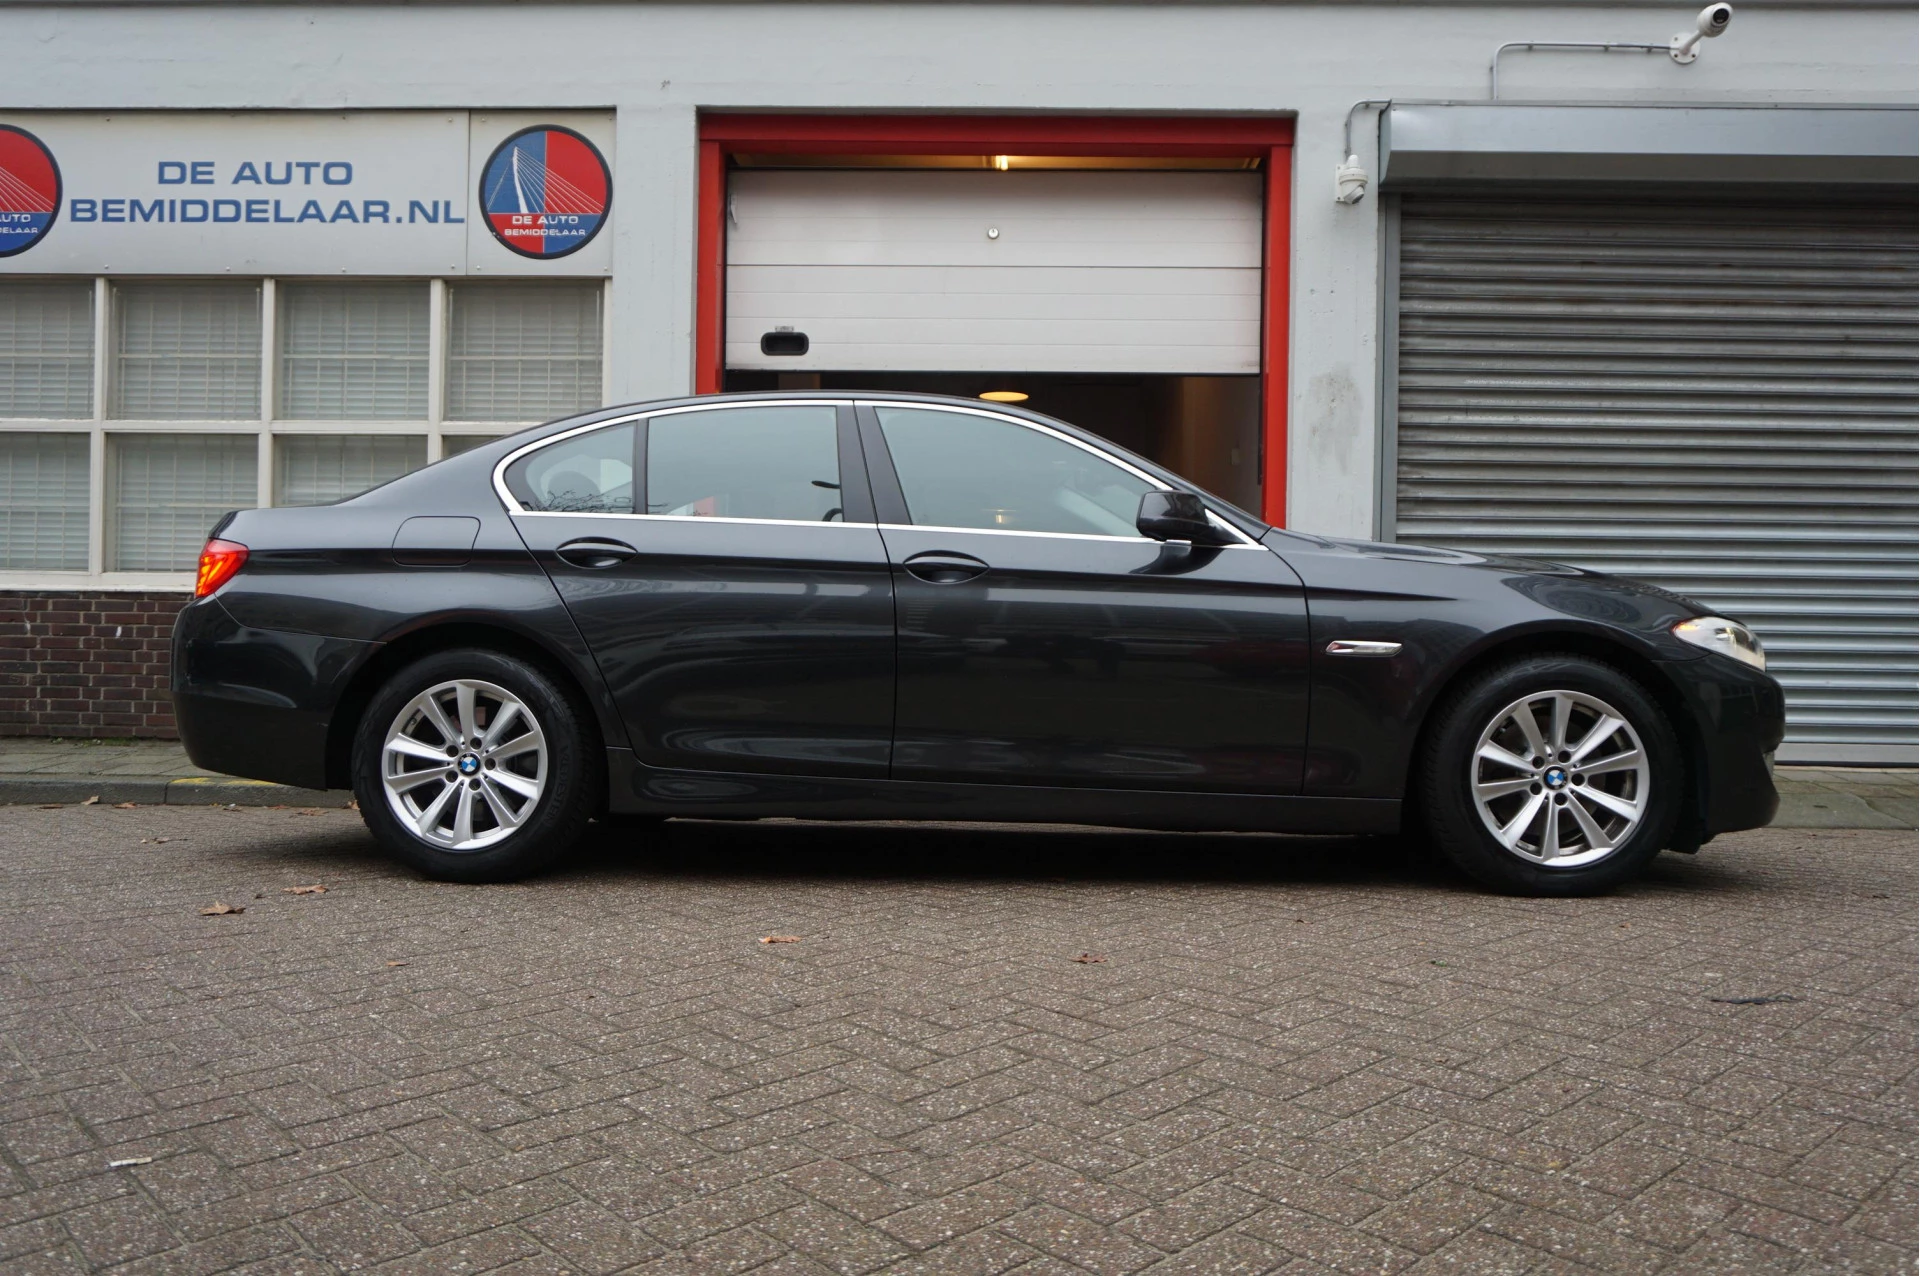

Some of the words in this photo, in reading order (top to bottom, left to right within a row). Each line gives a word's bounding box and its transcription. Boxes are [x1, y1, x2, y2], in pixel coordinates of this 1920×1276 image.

[157, 161, 216, 185] DE
[231, 161, 354, 185] AUTO
[70, 199, 465, 224] BEMIDDELAAR.NL
[0, 213, 32, 223] UTO
[512, 215, 533, 225] DE
[537, 215, 579, 225] AUTO
[0, 226, 39, 234] ELAAR
[504, 228, 586, 236] BEMIDDELAAR
